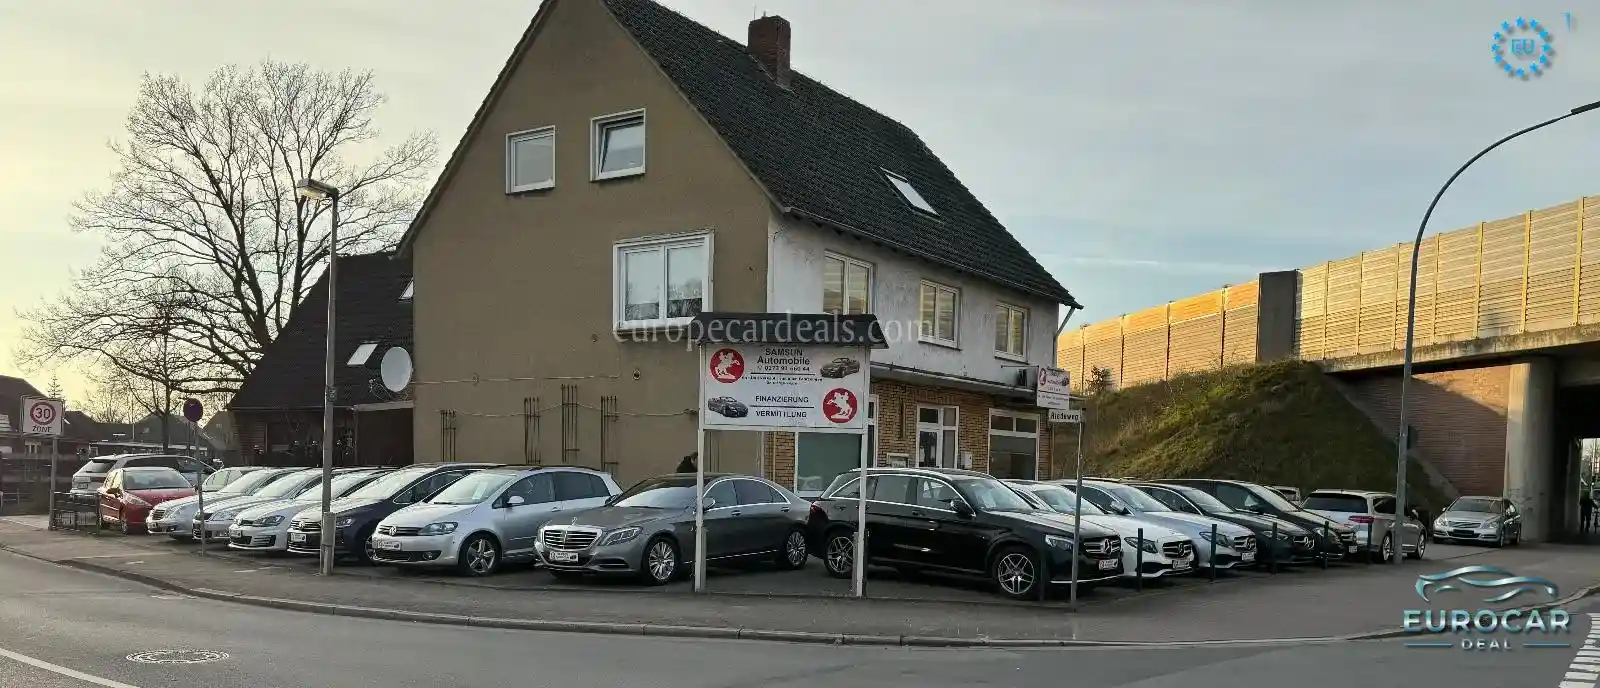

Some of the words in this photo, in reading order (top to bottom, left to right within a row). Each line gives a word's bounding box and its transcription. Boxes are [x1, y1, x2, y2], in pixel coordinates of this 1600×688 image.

[765, 348, 803, 356] SAMSUN
[757, 355, 810, 365] Automobile
[755, 395, 809, 403] FINANZIERUNG
[35, 408, 51, 419] 30
